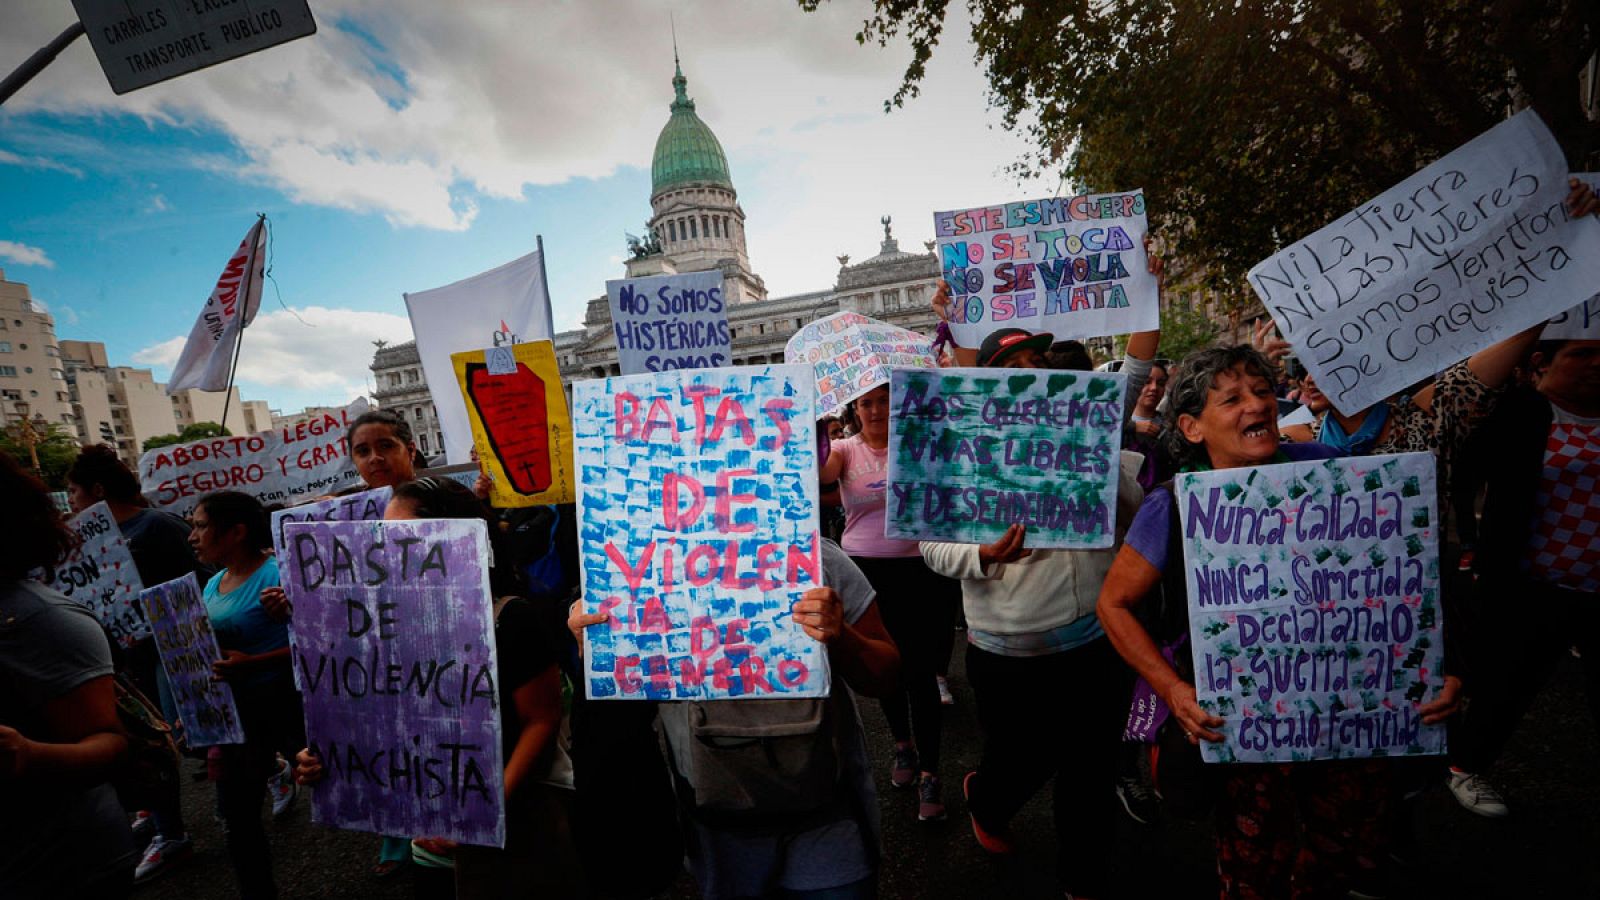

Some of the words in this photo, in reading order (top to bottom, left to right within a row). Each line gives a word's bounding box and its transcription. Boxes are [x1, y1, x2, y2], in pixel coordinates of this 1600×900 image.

[103, 8, 168, 45] CARRILES
[125, 32, 212, 74] TRANSPORTE
[220, 9, 283, 43] PUBLICO
[934, 207, 1004, 237] ESTE
[1005, 201, 1041, 229] ES
[1067, 192, 1146, 221] CUERPO
[1255, 252, 1307, 301] Ni
[1303, 236, 1355, 274] La
[1344, 170, 1468, 242] Tierra
[942, 242, 985, 272] NO
[992, 233, 1030, 260] SE
[1034, 226, 1134, 260] TOCA
[943, 267, 985, 296] NO
[993, 262, 1036, 294] SE
[944, 295, 985, 324] NO
[991, 292, 1038, 321] SE
[1044, 281, 1130, 316] MATA
[1274, 283, 1326, 334] Ni
[1324, 252, 1394, 309] Las
[1306, 277, 1441, 366] Somos
[1432, 202, 1568, 287] Territori
[1326, 353, 1381, 401] De
[982, 396, 1121, 433] QUEREMOS
[148, 437, 265, 478] ¡ABORTO
[283, 410, 353, 444] LEGAL
[1004, 439, 1112, 476] LIBRES
[157, 464, 264, 505] SEGURO
[277, 456, 288, 477] Y
[296, 436, 351, 470] GRAT
[288, 486, 305, 496] las
[307, 476, 340, 493] pobres
[662, 468, 759, 535] DE
[892, 482, 913, 517] Y
[1186, 488, 1287, 545] Nunca
[60, 555, 100, 596] SON
[293, 532, 447, 593] BASTA
[1291, 555, 1423, 605] Sometida
[345, 599, 401, 640] DE
[598, 596, 673, 634] CIA
[690, 615, 756, 658] DE
[614, 656, 809, 694] GENERO
[1206, 652, 1233, 692] la
[1250, 649, 1348, 702] guerra
[1363, 645, 1394, 692] al
[1143, 693, 1157, 731] somos
